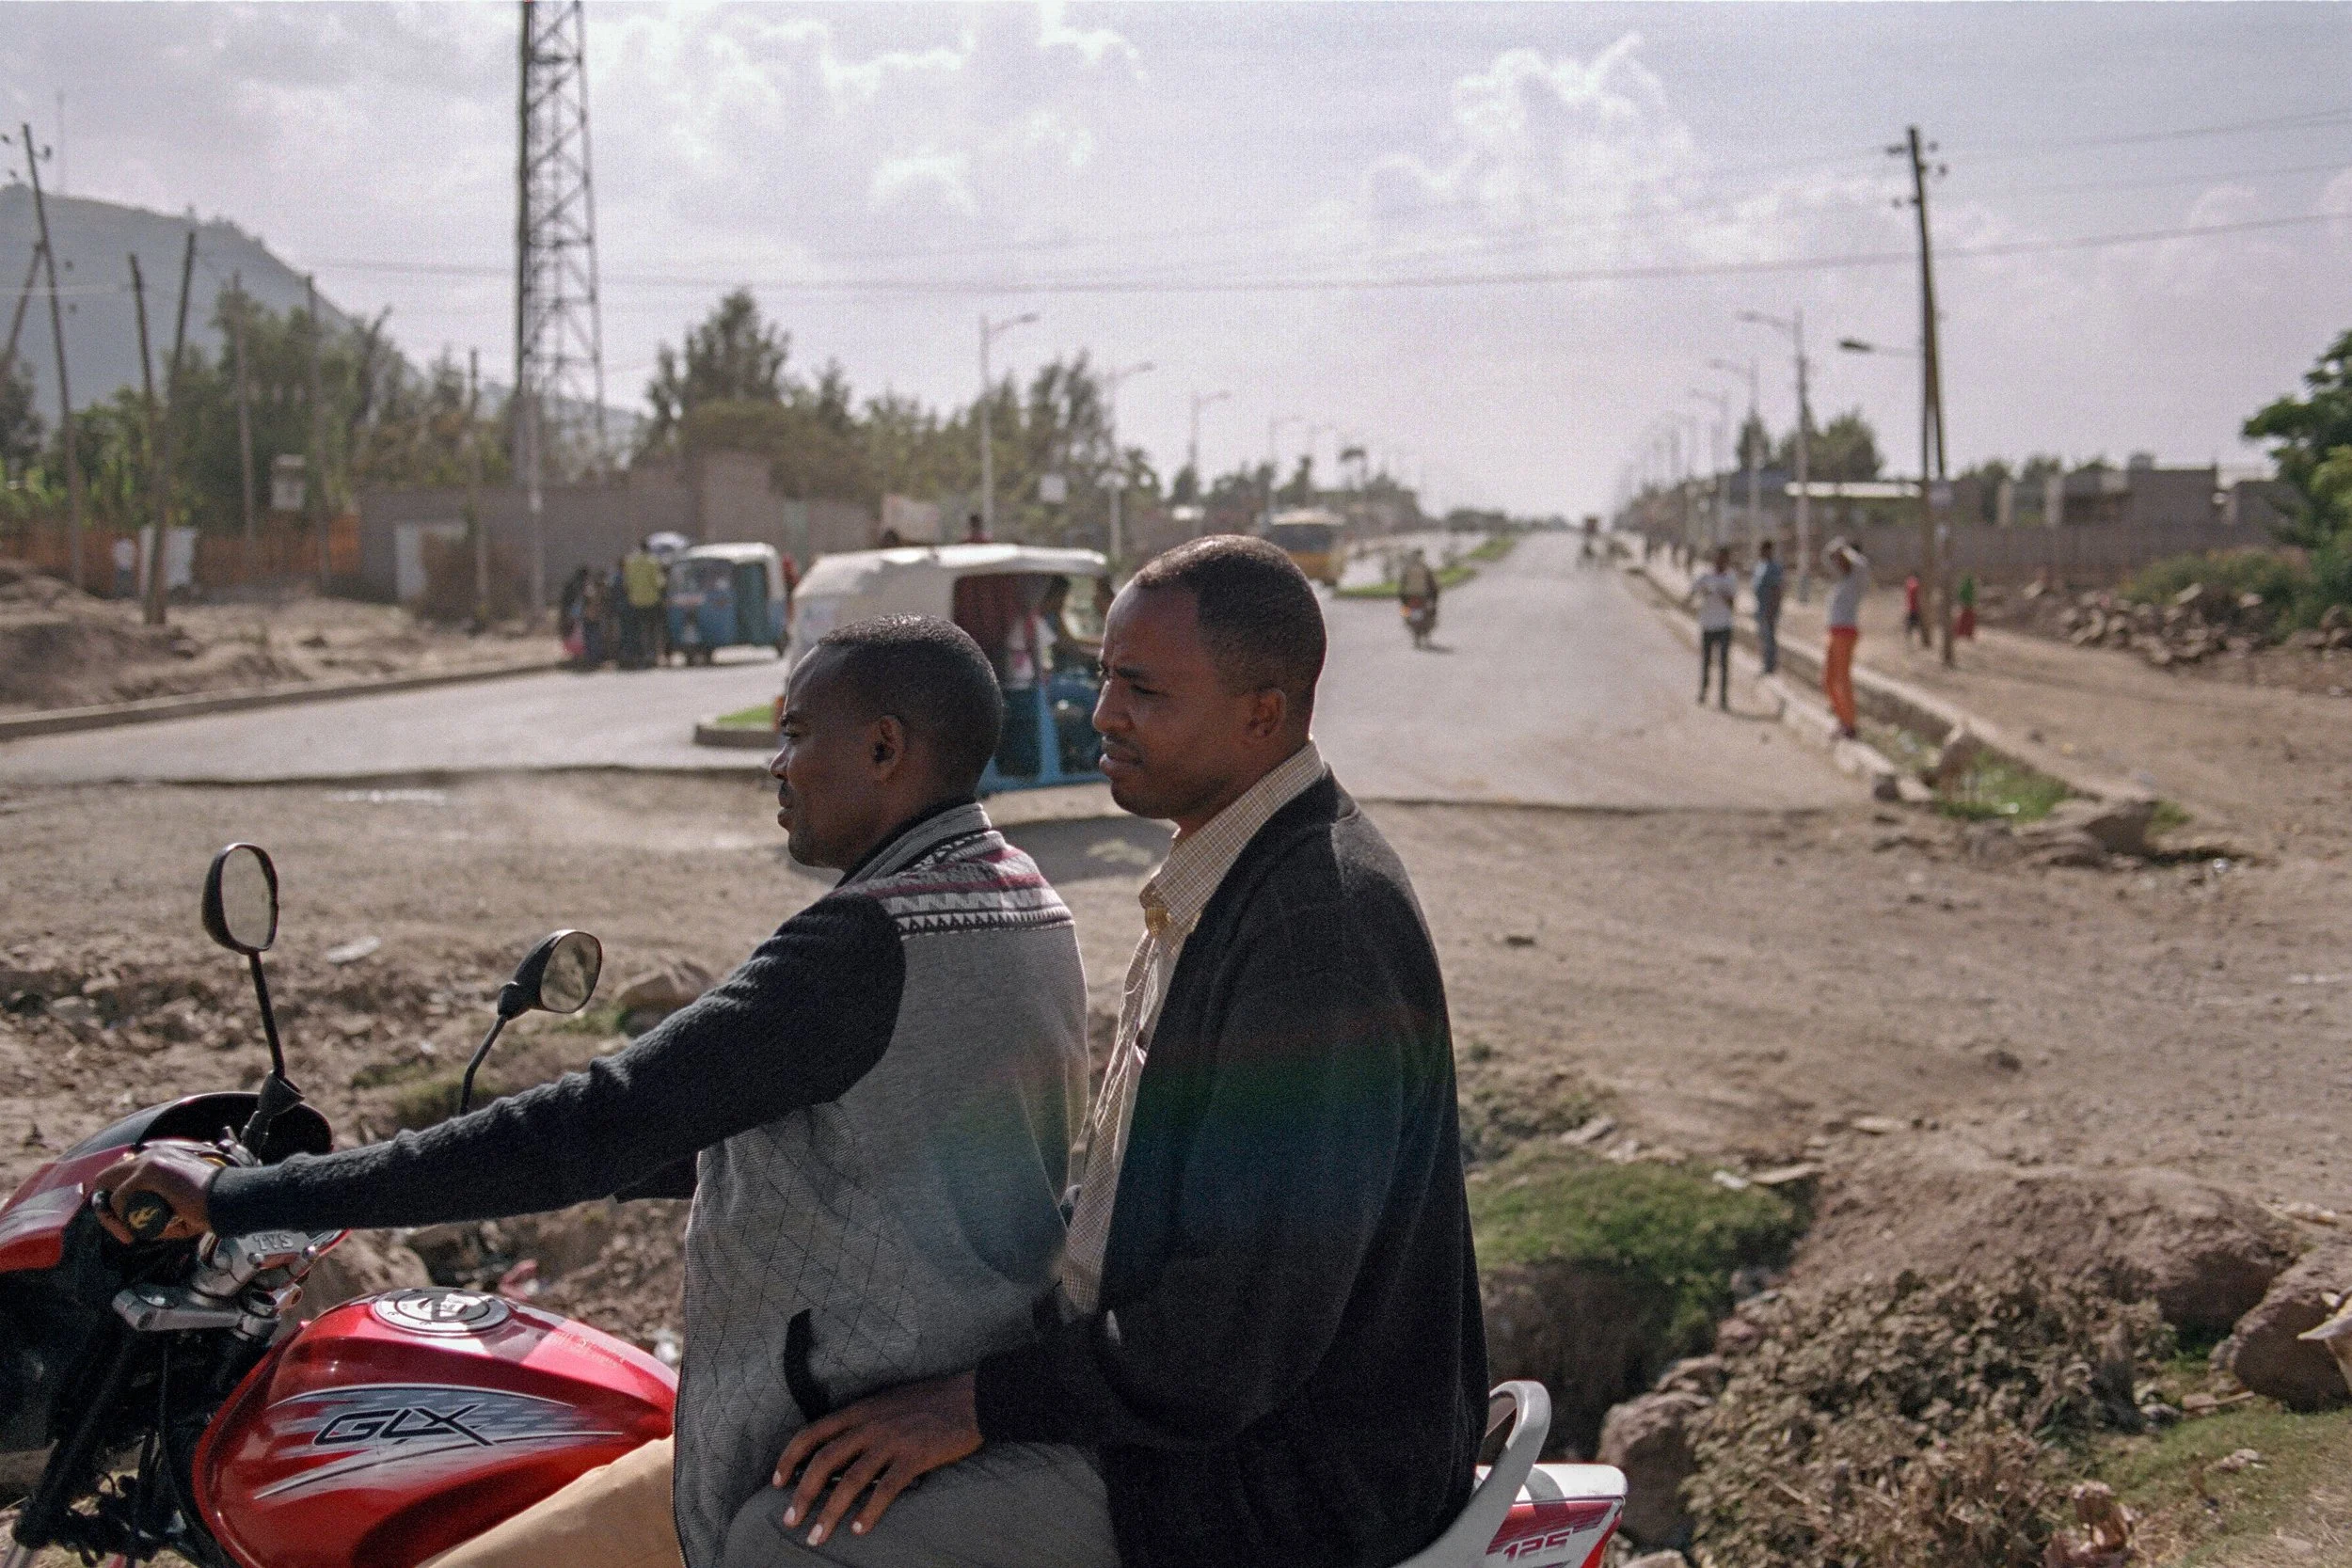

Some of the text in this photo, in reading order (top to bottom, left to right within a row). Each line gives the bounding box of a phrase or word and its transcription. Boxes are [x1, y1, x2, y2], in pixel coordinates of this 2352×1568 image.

[253, 1232, 294, 1251] TVS
[313, 1402, 498, 1448] GLX
[1502, 1527, 1574, 1561] 125
